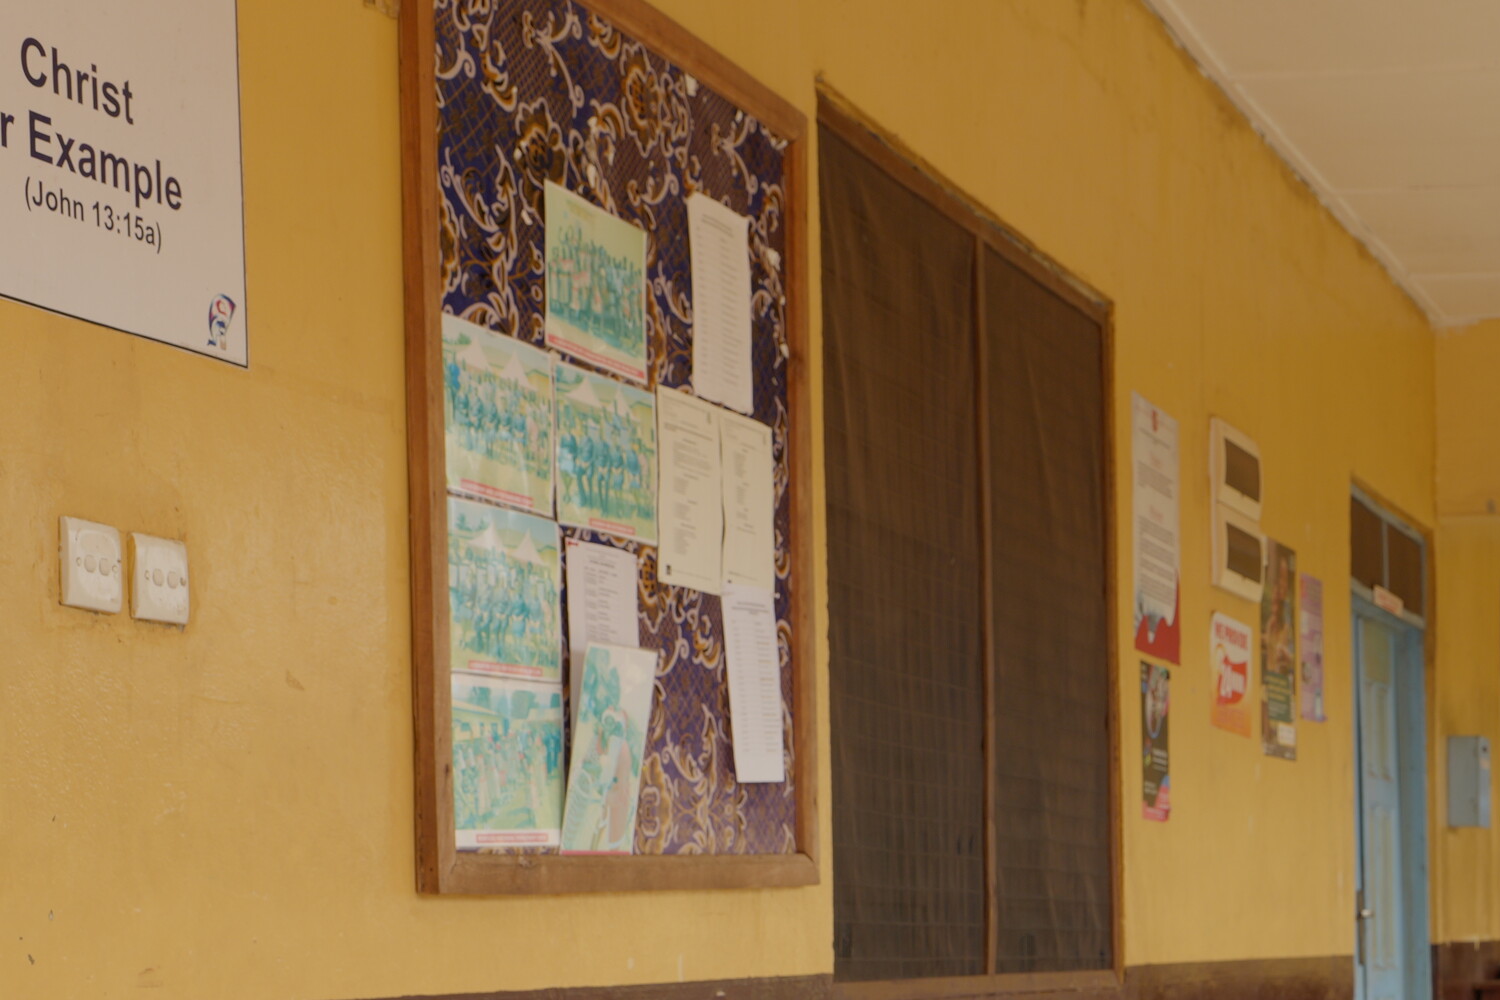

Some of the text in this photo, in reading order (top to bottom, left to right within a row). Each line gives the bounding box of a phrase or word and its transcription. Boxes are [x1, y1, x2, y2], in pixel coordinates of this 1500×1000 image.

[20, 37, 134, 126] Christ
[28, 109, 182, 211] Example
[24, 176, 162, 254] (John 13:15a)
